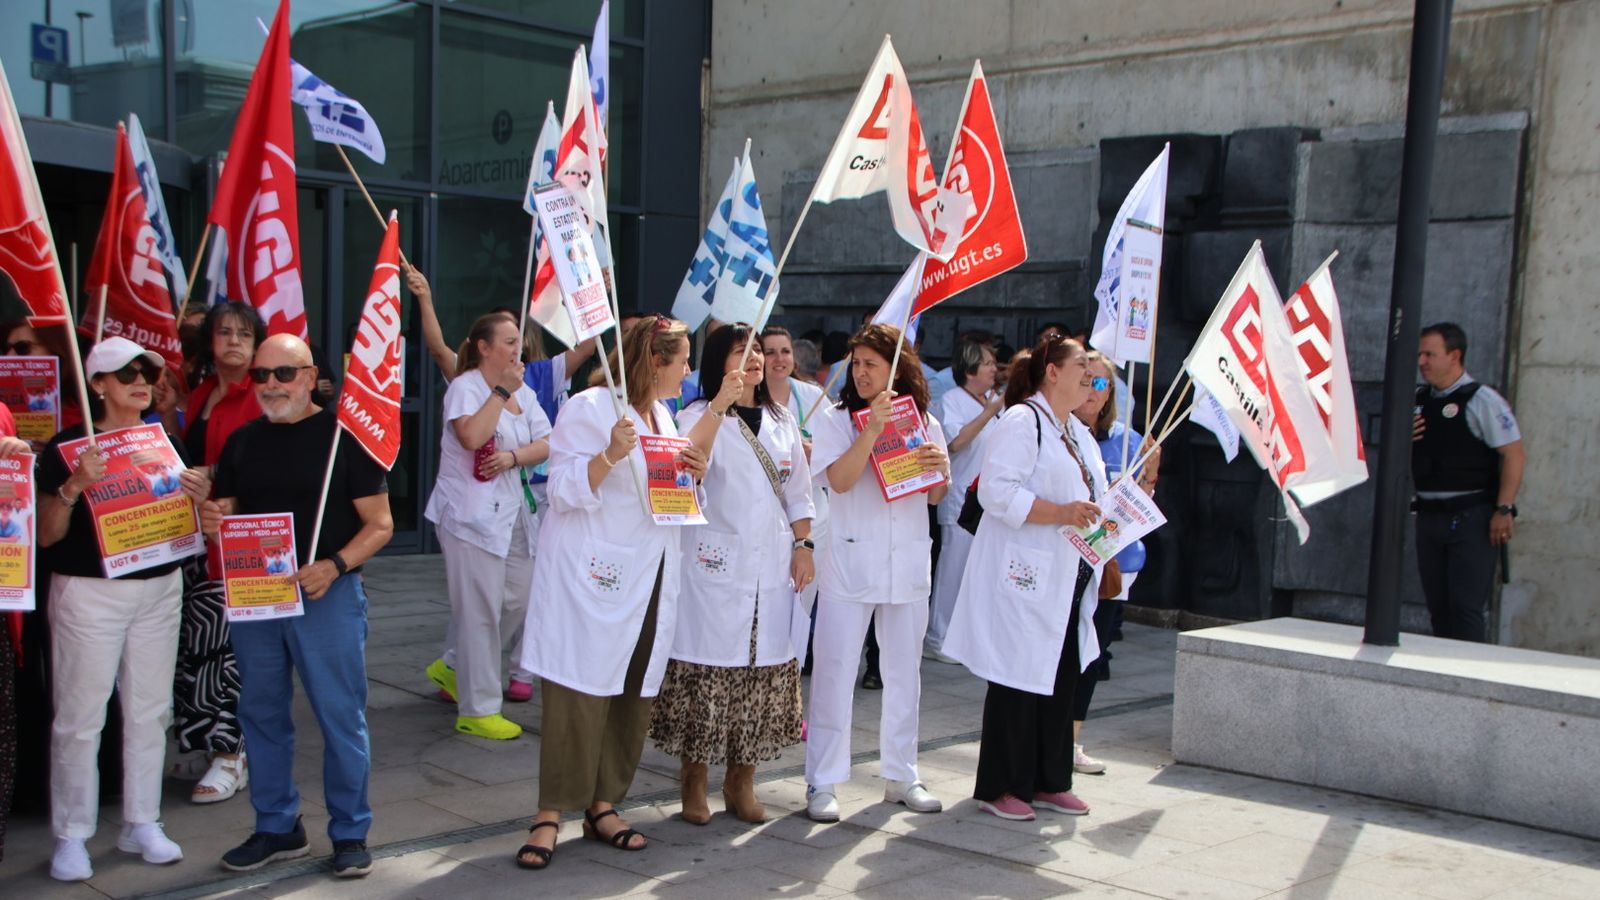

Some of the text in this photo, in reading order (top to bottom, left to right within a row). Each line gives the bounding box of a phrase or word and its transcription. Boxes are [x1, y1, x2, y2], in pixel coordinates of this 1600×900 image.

[545, 197, 568, 212] CONTRA
[123, 431, 155, 443] TÉCNICO
[750, 438, 764, 457] LOLA
[872, 438, 904, 456] HUELGA
[648, 469, 675, 480] HUELGA
[90, 478, 148, 505] HUELGA
[104, 498, 188, 527] CONCENTRACIÓN
[129, 523, 140, 533] 25
[229, 519, 285, 529] PERSONAL TÉCNICO
[1072, 537, 1091, 557] CCOO
[110, 556, 129, 568] UGT
[225, 556, 265, 569] HUELGA
